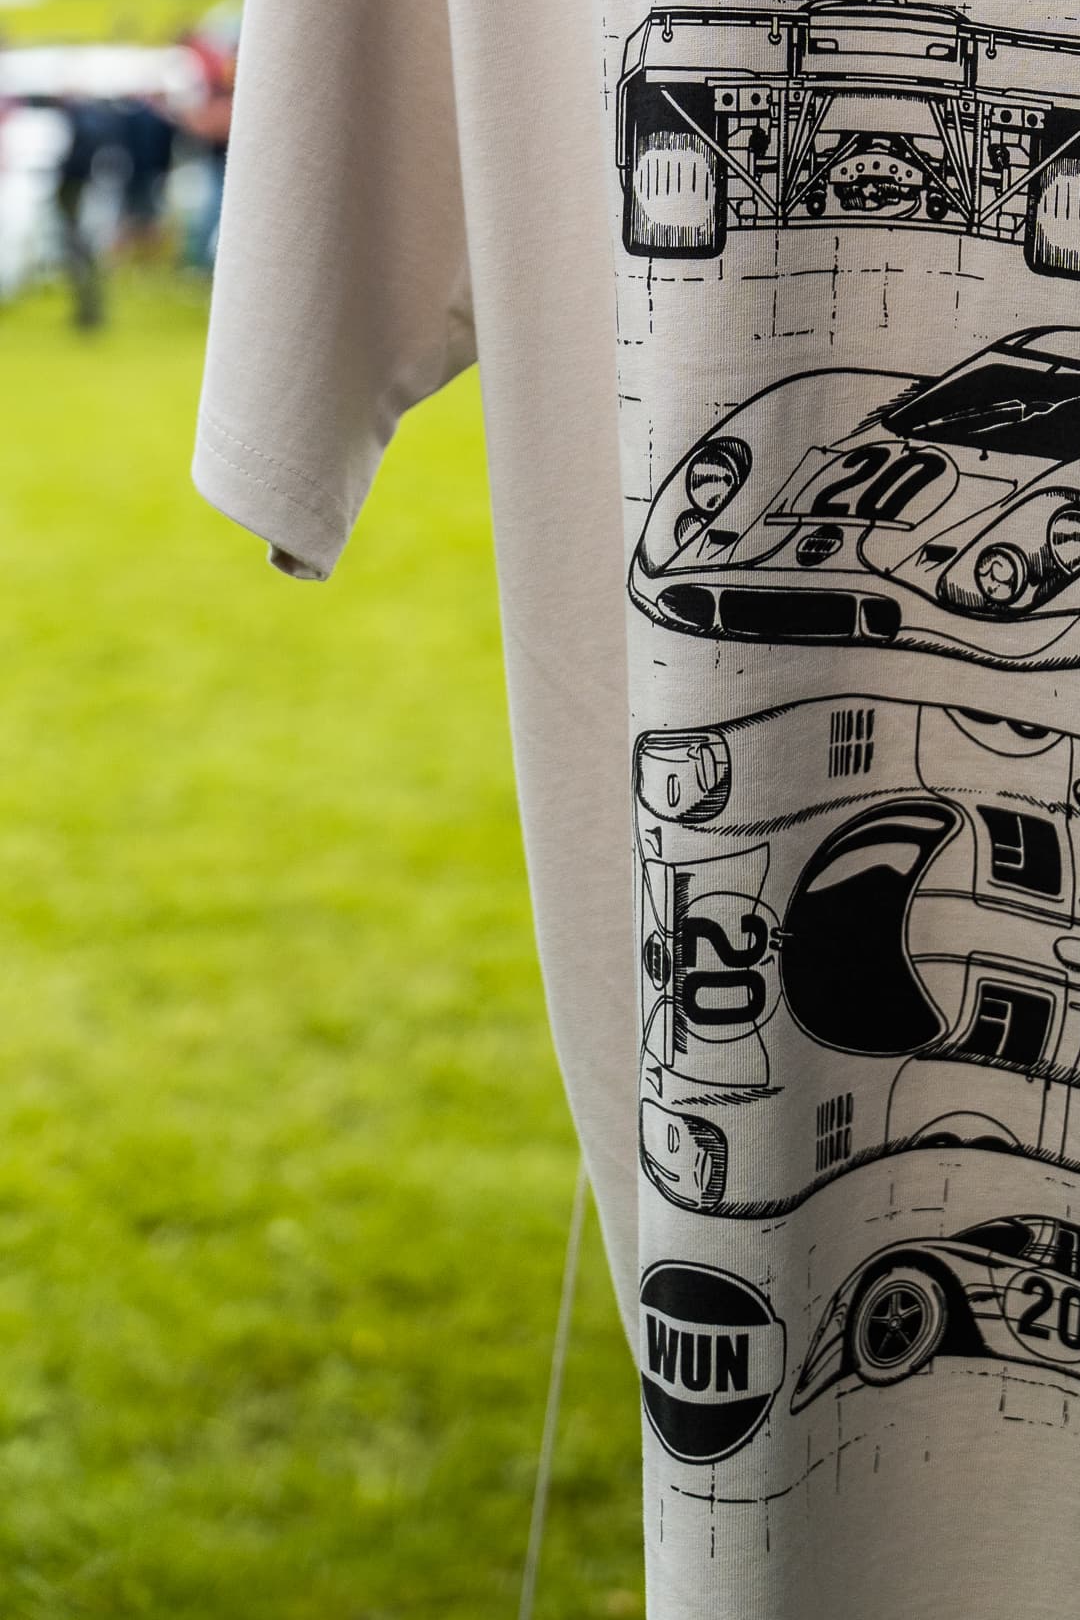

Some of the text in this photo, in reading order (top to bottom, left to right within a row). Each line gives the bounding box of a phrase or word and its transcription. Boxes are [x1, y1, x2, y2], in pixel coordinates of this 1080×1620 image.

[811, 447, 947, 521] 20
[682, 912, 769, 1026] 20
[646, 1313, 750, 1393] WUN
